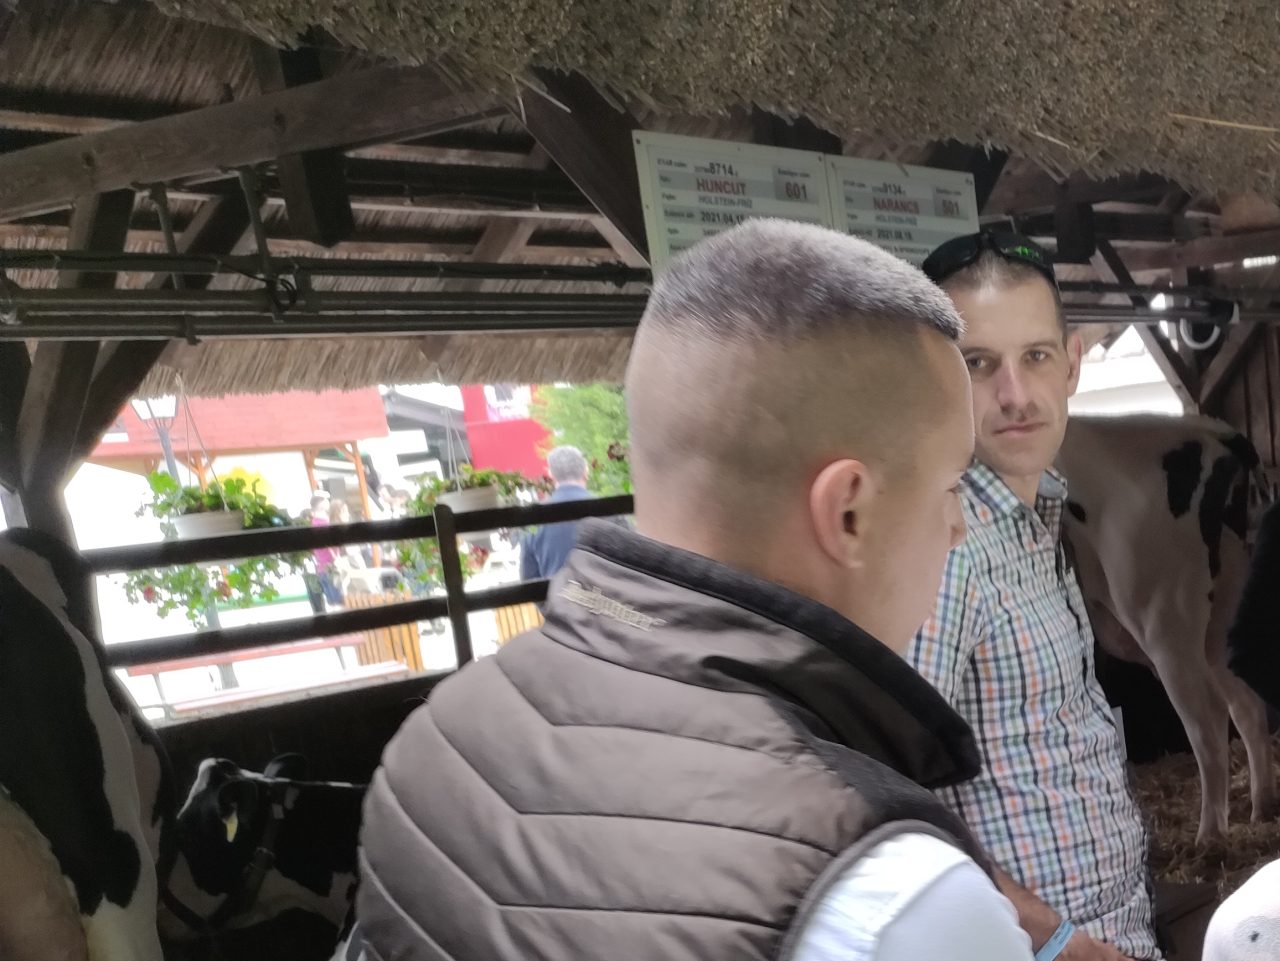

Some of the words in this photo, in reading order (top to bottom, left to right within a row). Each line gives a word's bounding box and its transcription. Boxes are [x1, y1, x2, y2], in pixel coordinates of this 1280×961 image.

[696, 178, 746, 195] HUNCUT
[785, 182, 807, 200] 601
[873, 197, 920, 215] NARANCS
